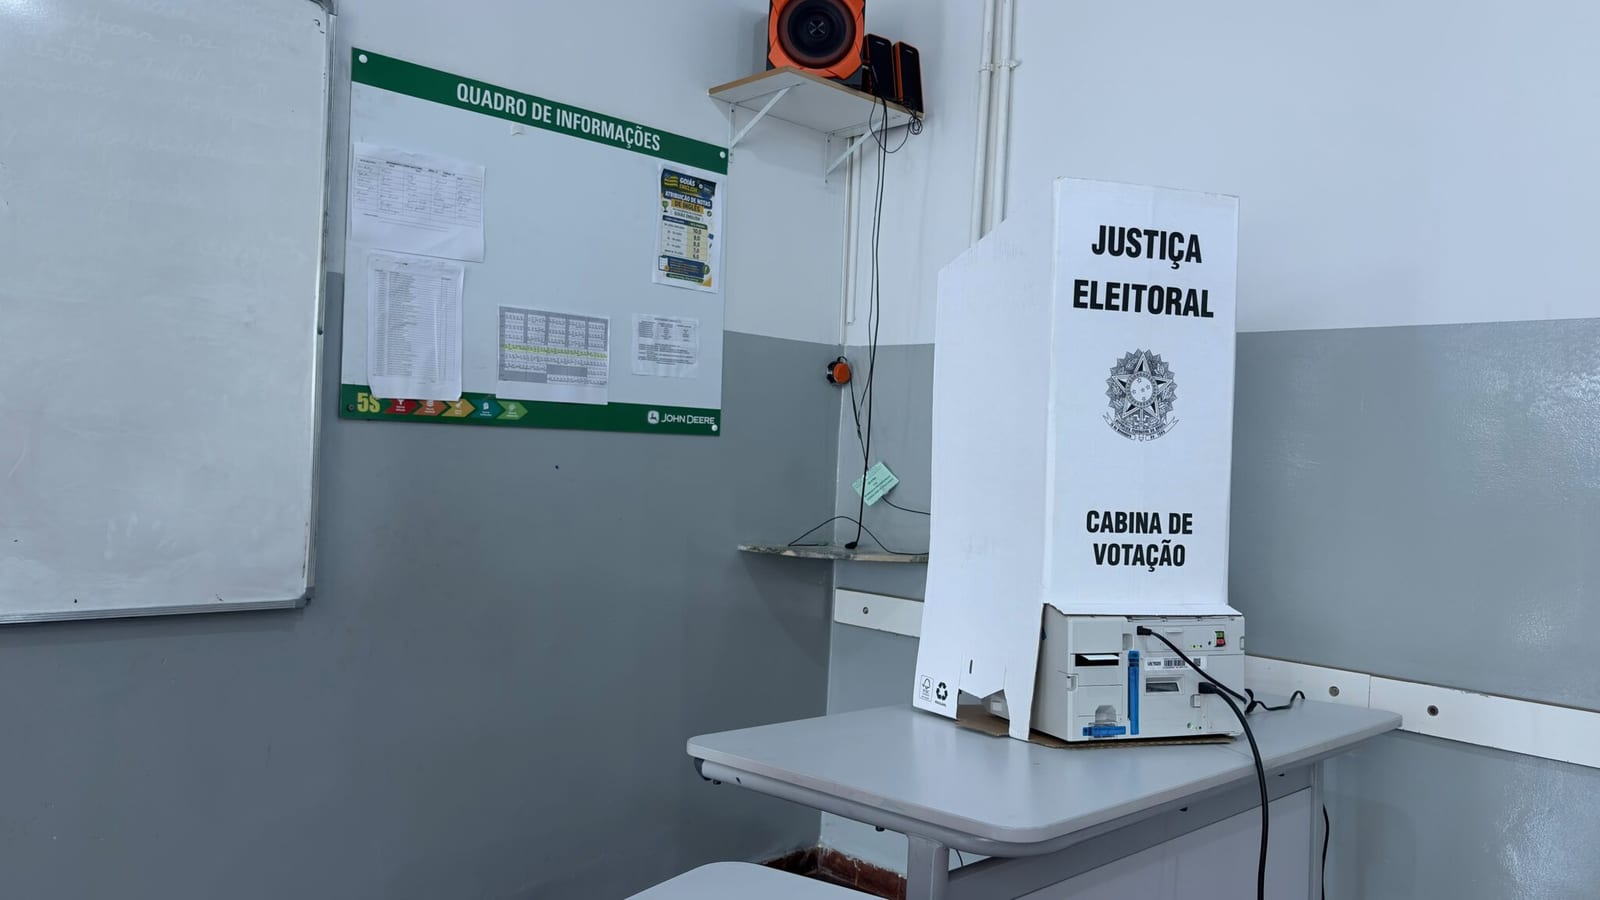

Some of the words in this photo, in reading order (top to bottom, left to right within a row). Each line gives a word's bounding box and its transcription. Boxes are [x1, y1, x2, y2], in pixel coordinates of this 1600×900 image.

[456, 82, 527, 117] QUADRO
[531, 102, 552, 124] DE
[556, 108, 661, 151] INFORMAÇÕES
[680, 177, 696, 187] GOIÁS
[697, 199, 711, 207] NOTAS
[1091, 225, 1203, 270] JUSTIÇA
[1073, 279, 1214, 318] ELEITORAL
[357, 392, 381, 414] 5S
[661, 413, 686, 424] JOHN
[686, 414, 715, 425] DEERE
[1086, 510, 1162, 534] CABINA
[1168, 512, 1193, 535] DE
[1093, 539, 1186, 572] VOTAÇÃO
